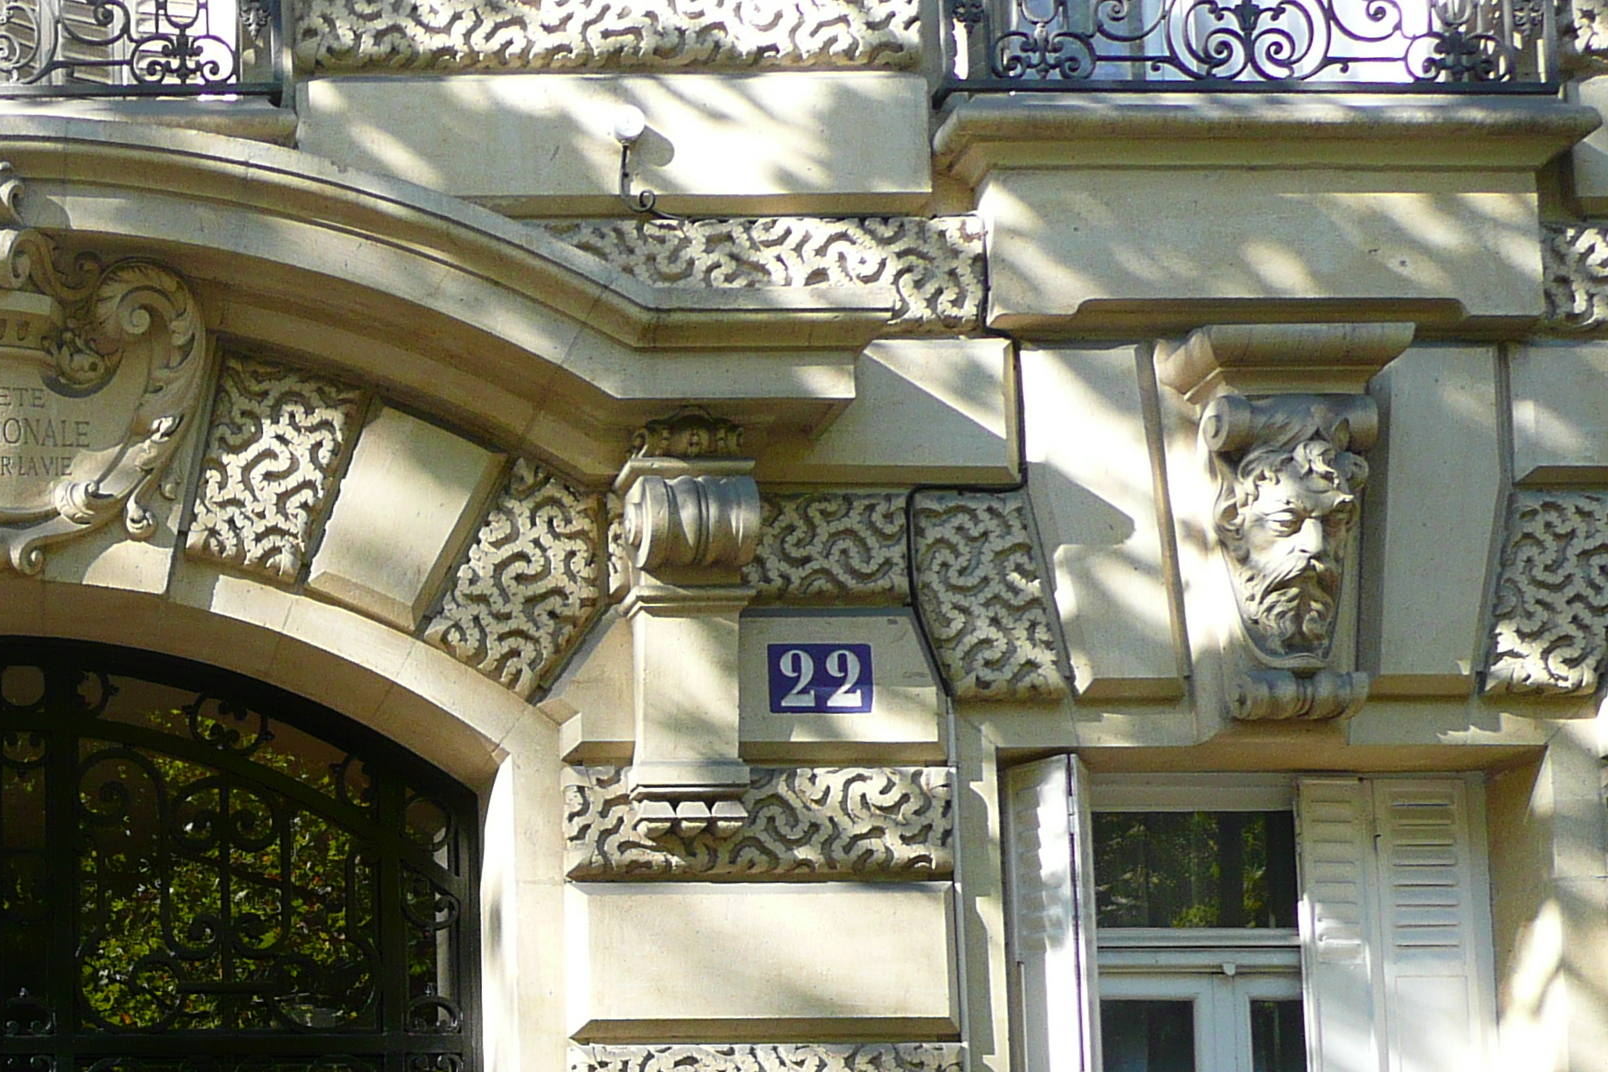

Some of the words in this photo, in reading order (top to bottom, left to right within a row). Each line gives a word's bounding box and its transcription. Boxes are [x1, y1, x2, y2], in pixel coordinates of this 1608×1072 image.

[17, 455, 39, 477] LA
[40, 456, 73, 477] VIE
[779, 649, 863, 708] 22
